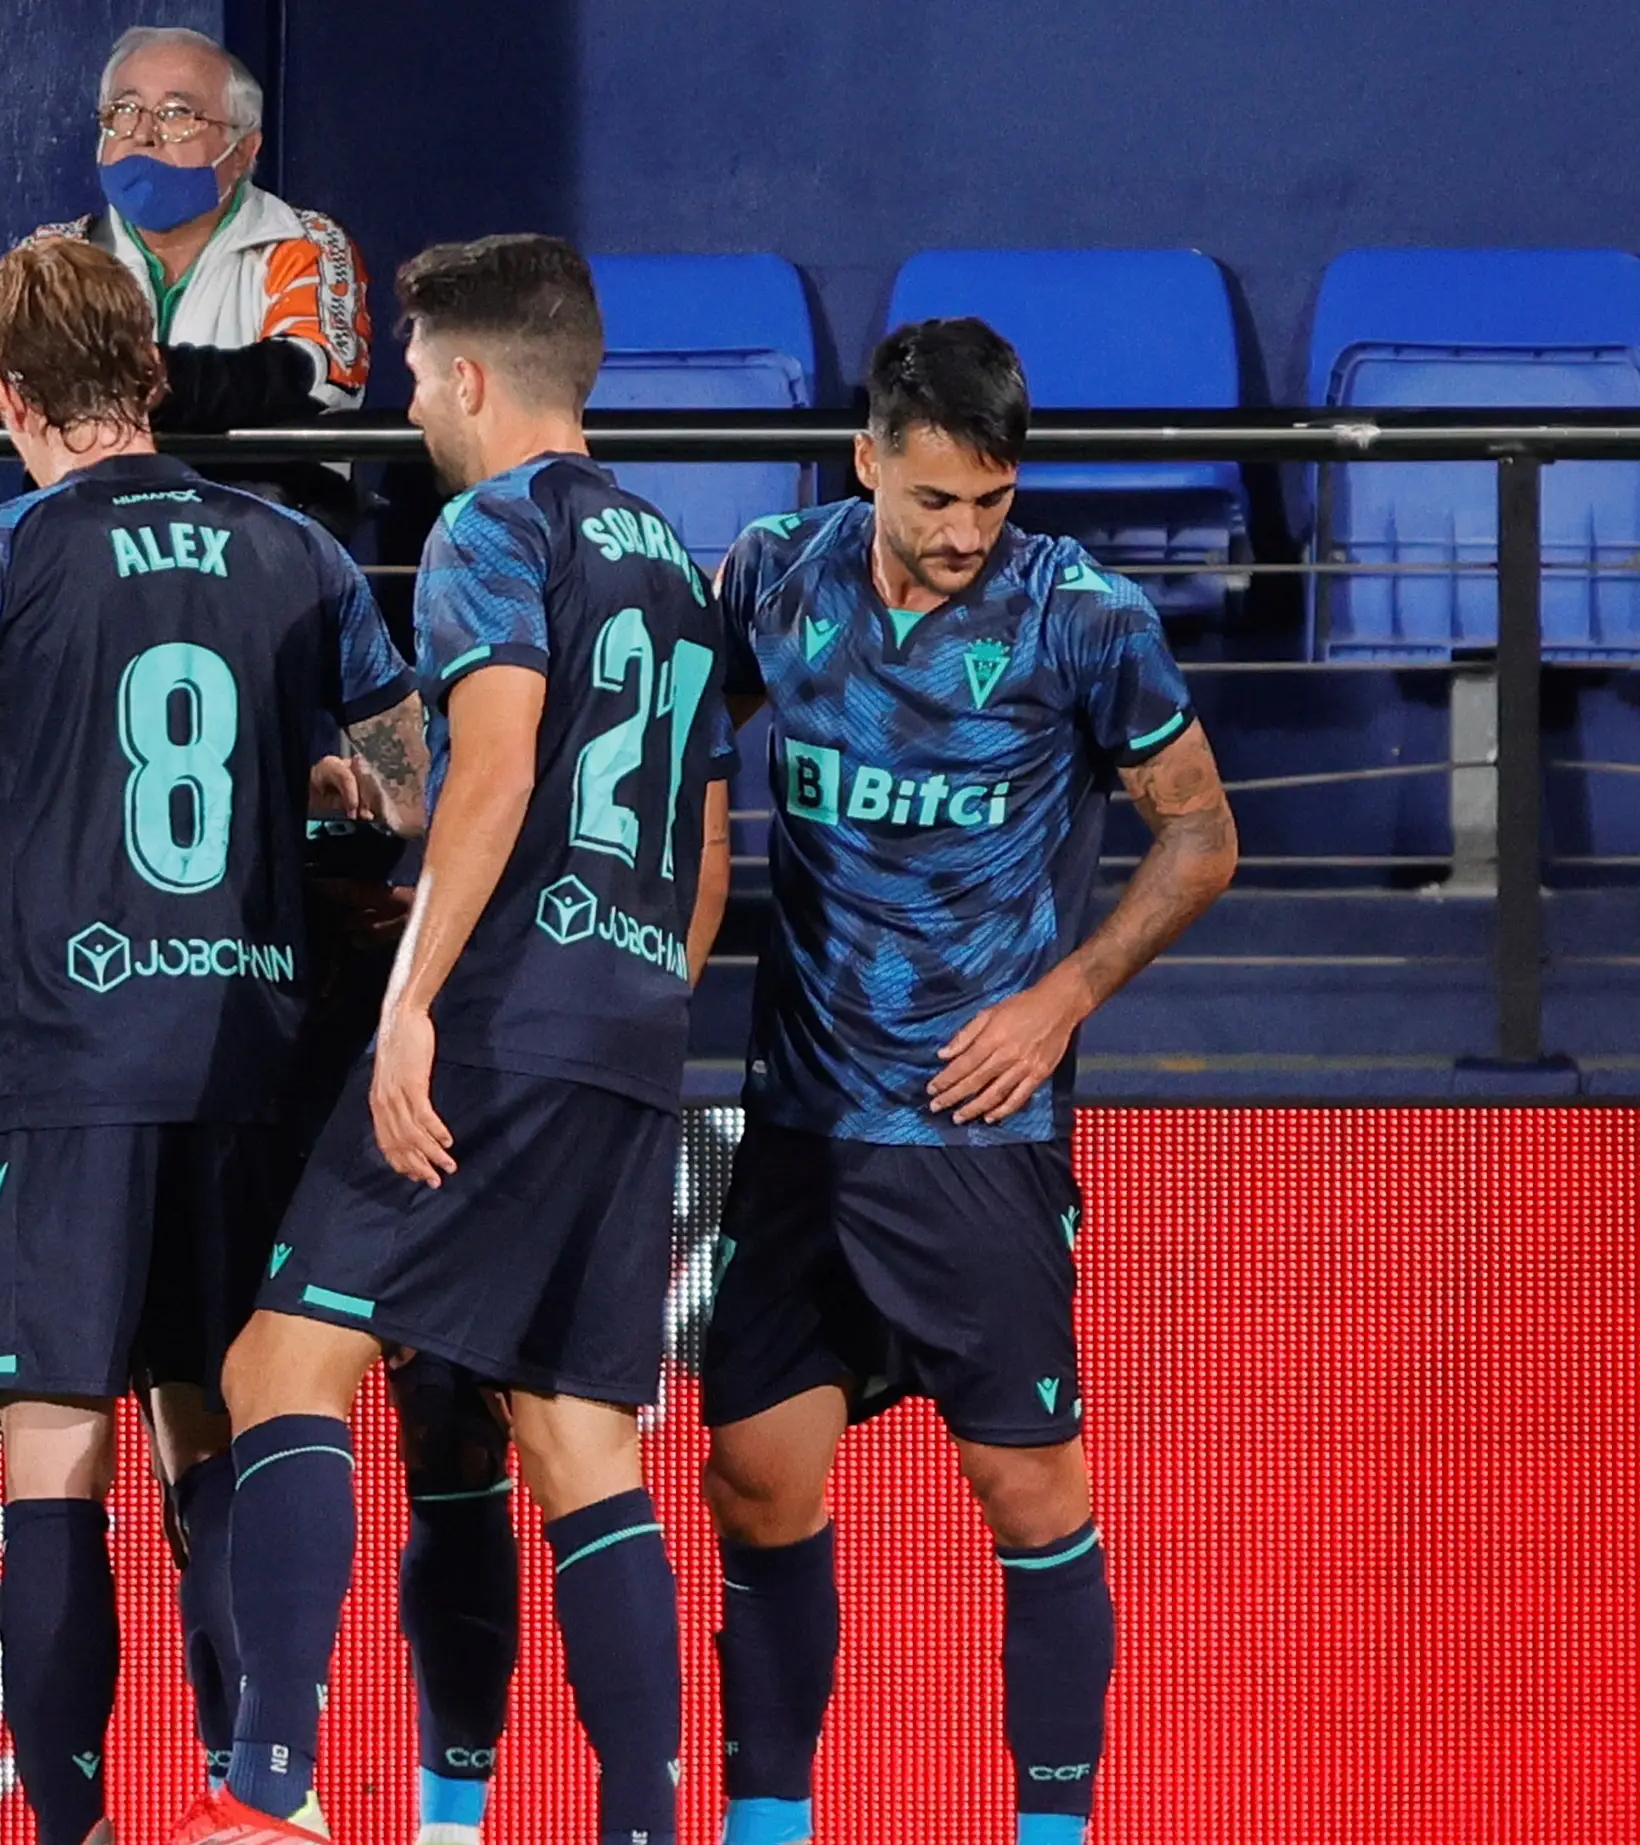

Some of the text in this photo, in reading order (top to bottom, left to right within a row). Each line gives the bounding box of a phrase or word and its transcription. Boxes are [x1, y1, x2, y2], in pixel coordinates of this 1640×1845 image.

[111, 522, 231, 578] ALEX
[118, 642, 238, 894] 8
[569, 608, 714, 881] 21
[846, 765, 1010, 827] Bitci
[1028, 1763, 1091, 1781] CCF
